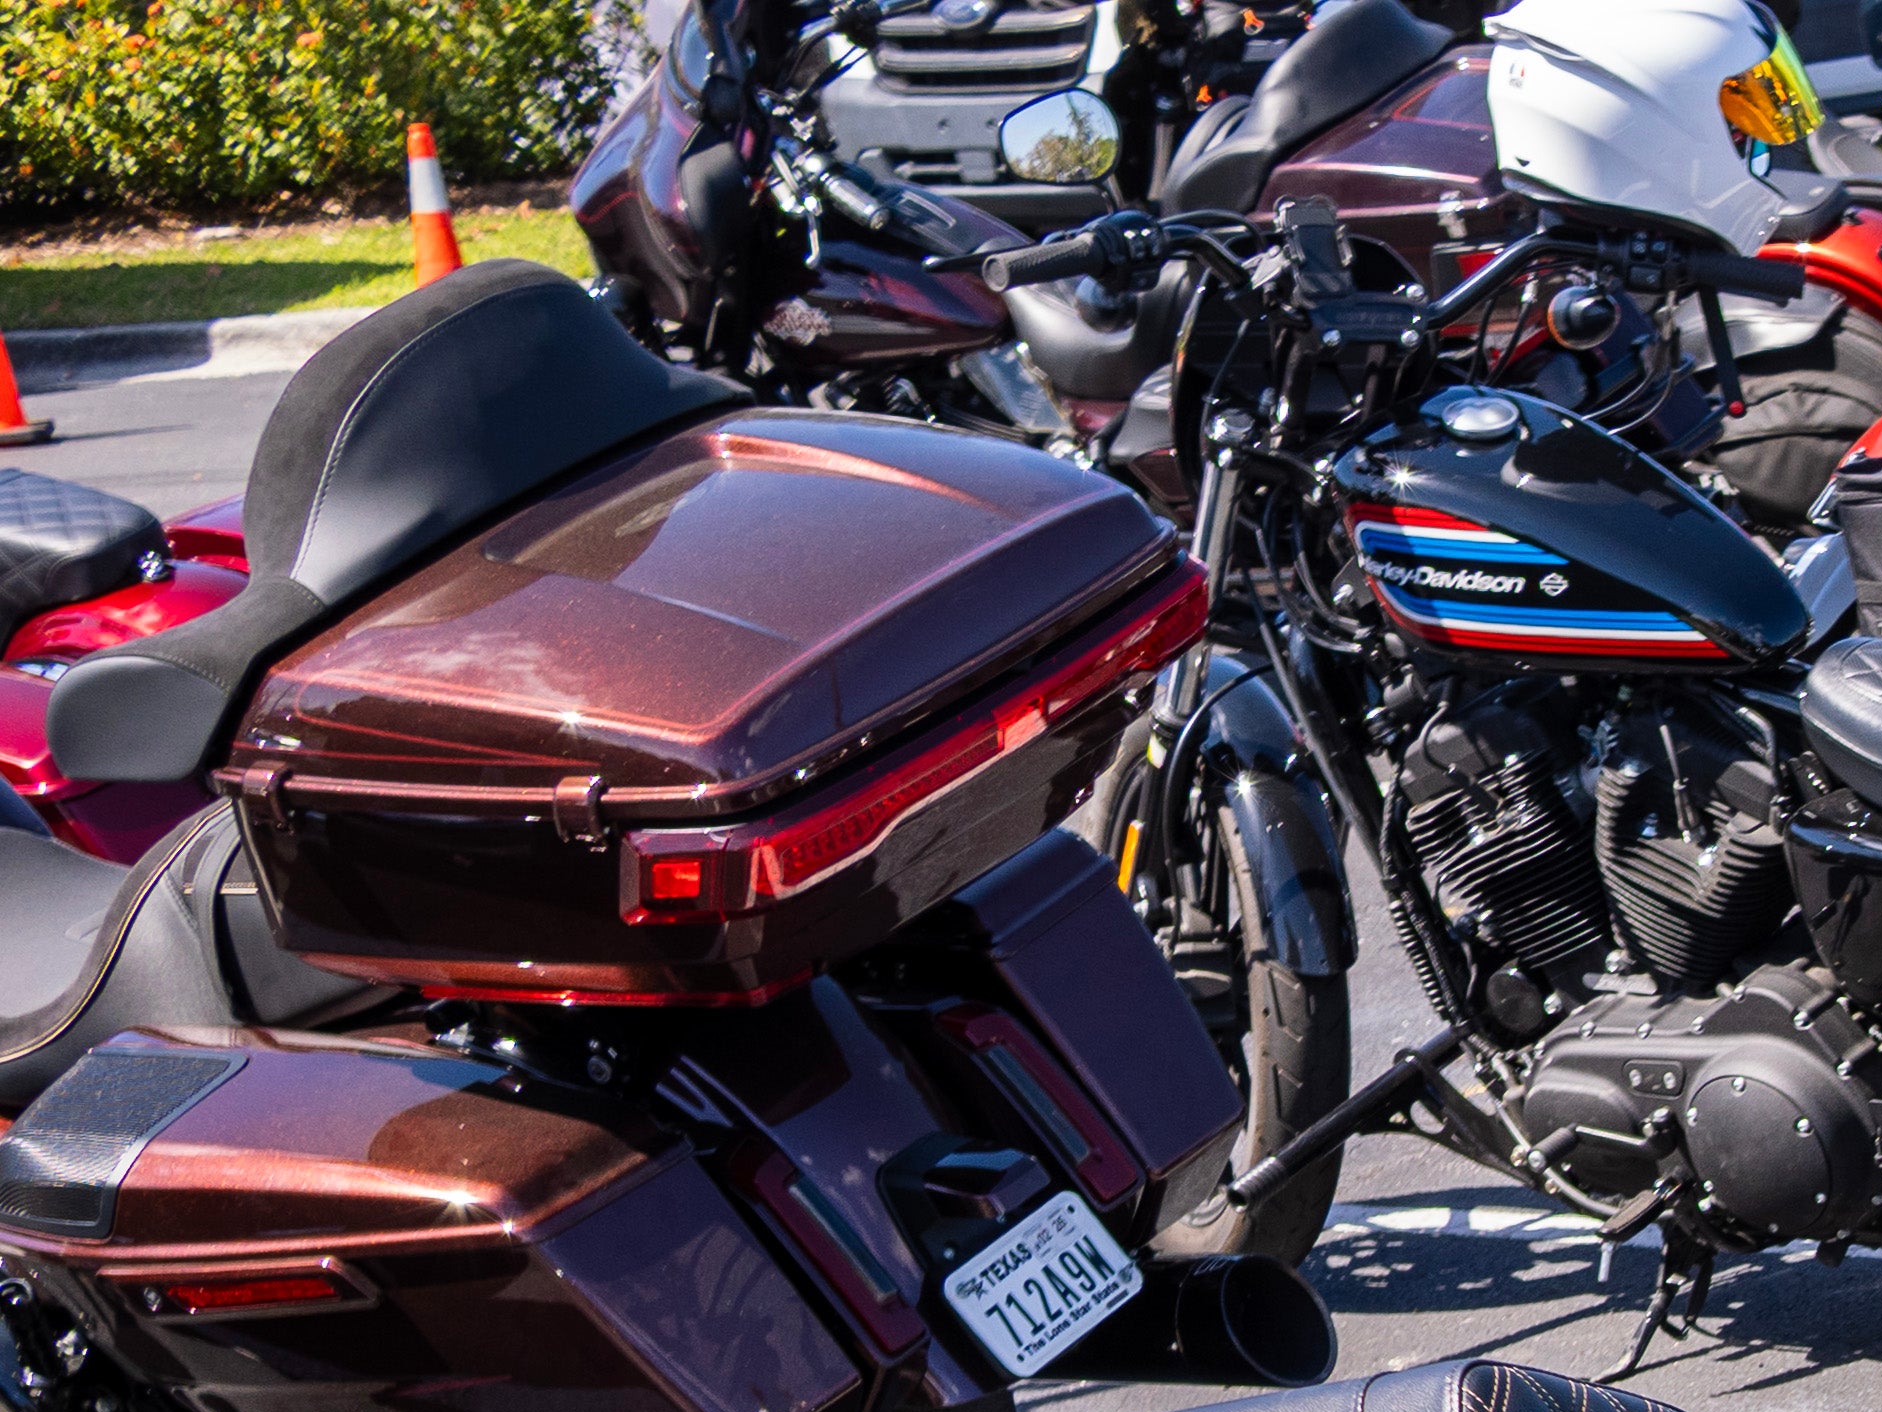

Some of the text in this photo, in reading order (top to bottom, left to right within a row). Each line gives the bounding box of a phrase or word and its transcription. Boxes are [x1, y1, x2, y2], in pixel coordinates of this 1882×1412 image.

[978, 1242, 1034, 1288] TEXAS
[984, 1234, 1117, 1348] 712A9W
[1023, 1280, 1121, 1358] The Lone Star State
